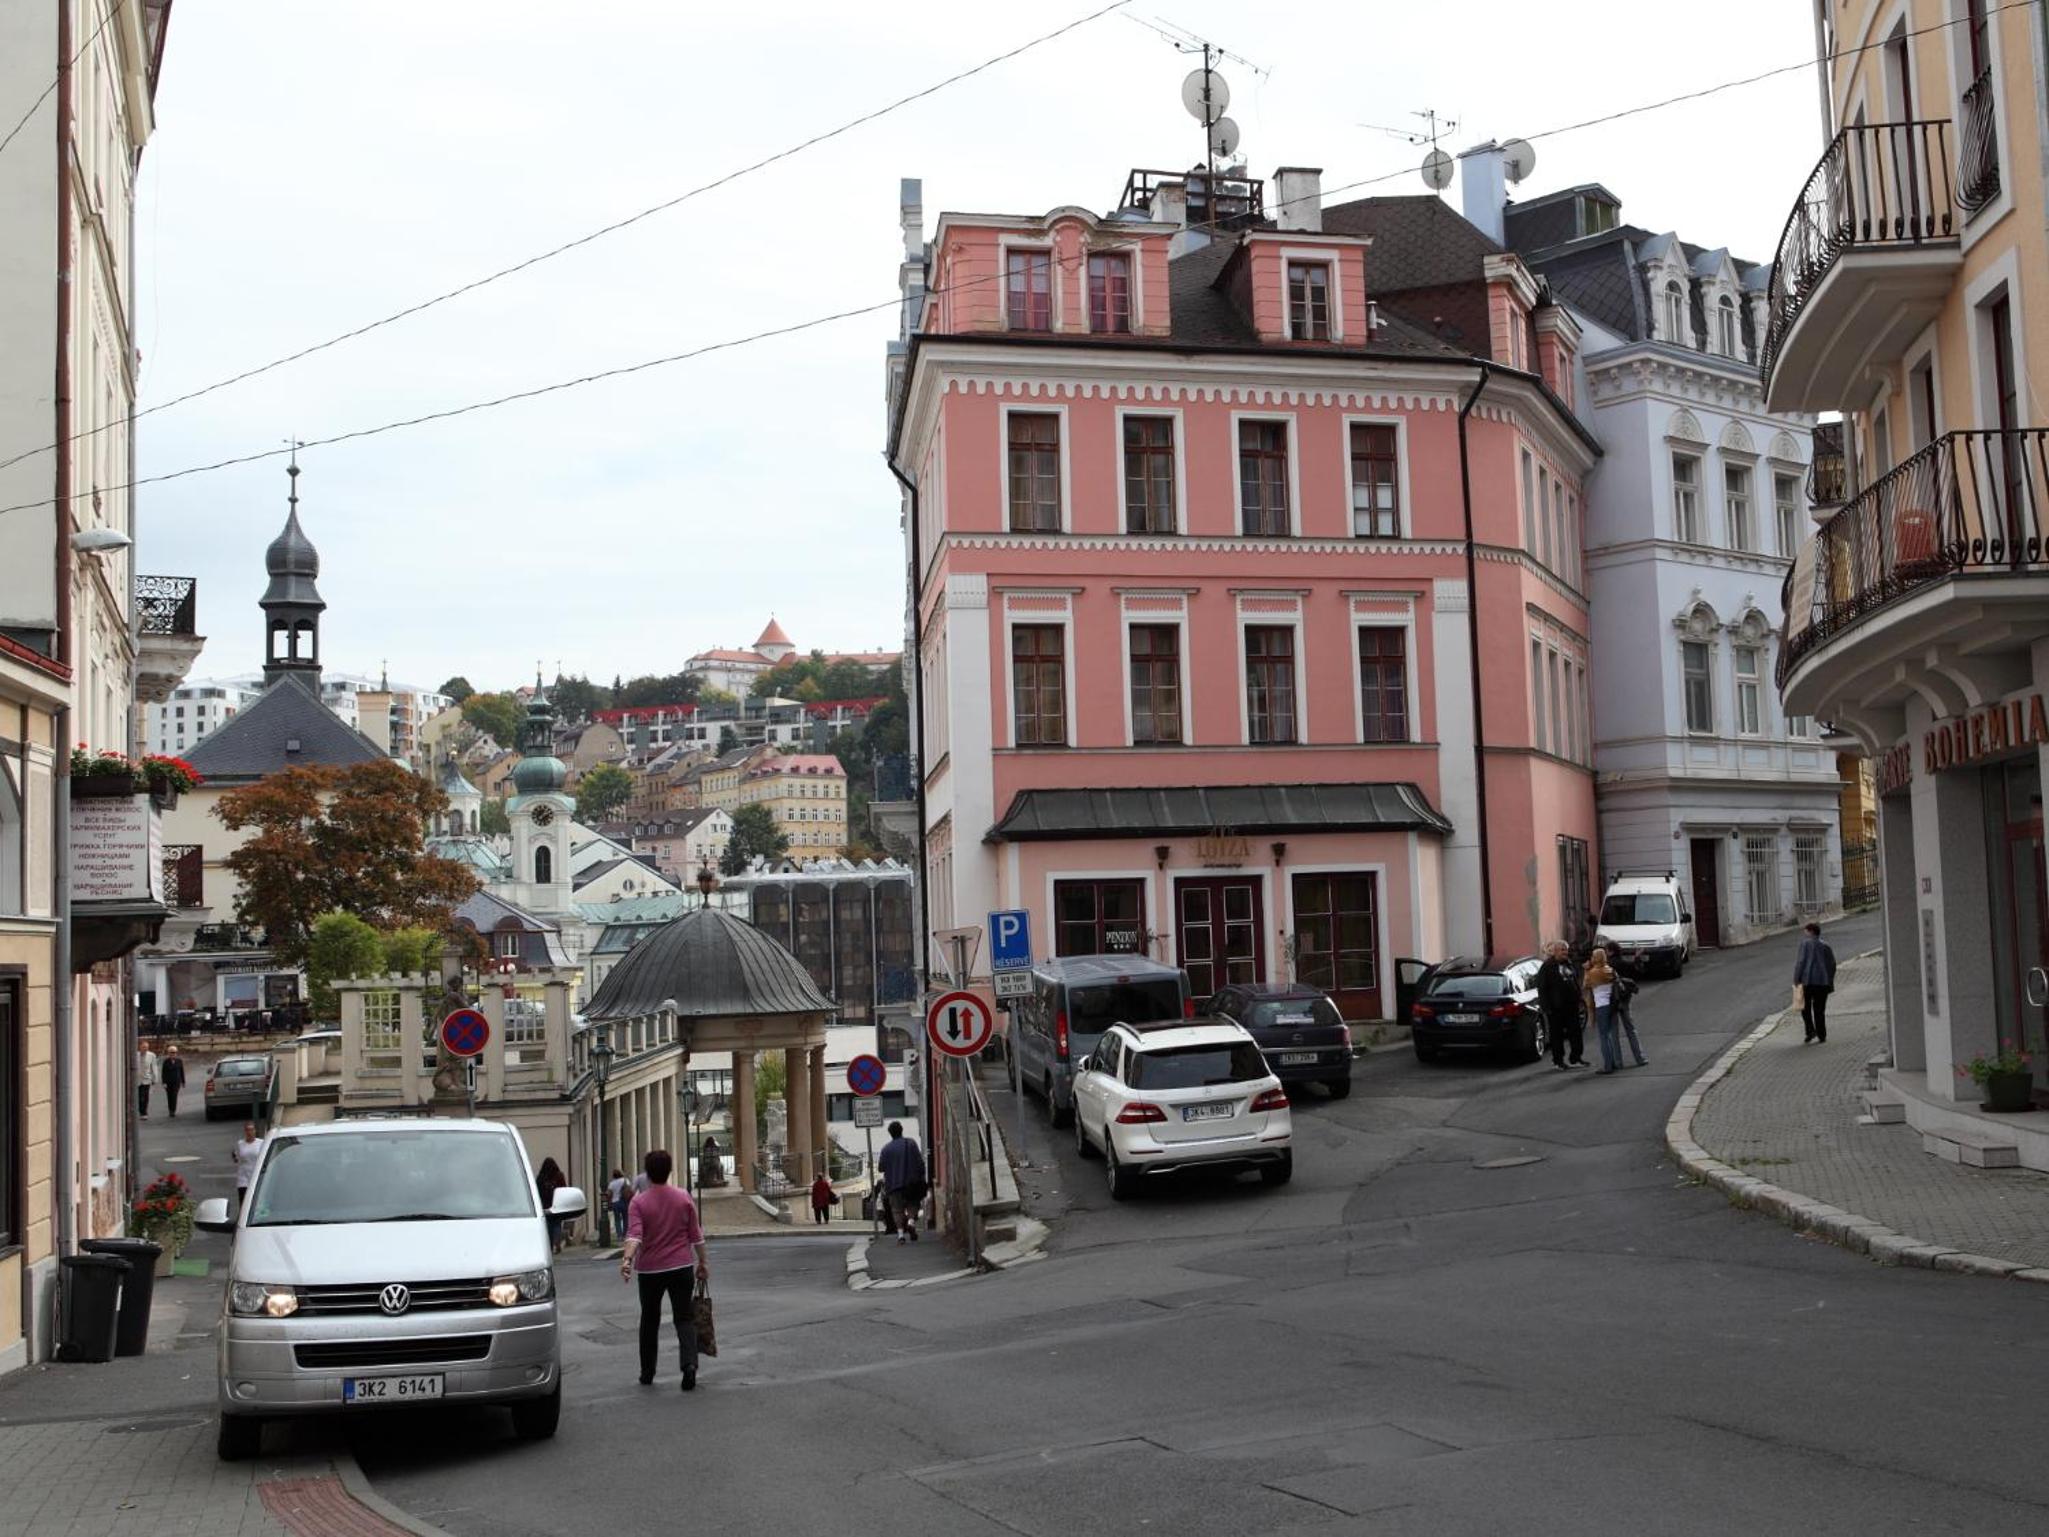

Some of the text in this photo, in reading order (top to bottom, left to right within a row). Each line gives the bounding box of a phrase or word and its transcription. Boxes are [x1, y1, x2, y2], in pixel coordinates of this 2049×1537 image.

[1924, 693, 2049, 776] BOHEMIA
[84, 816, 127, 824] ВСЕ ВИДЫ
[999, 915, 1020, 948] P
[358, 1378, 436, 1397] 3K2 6141
